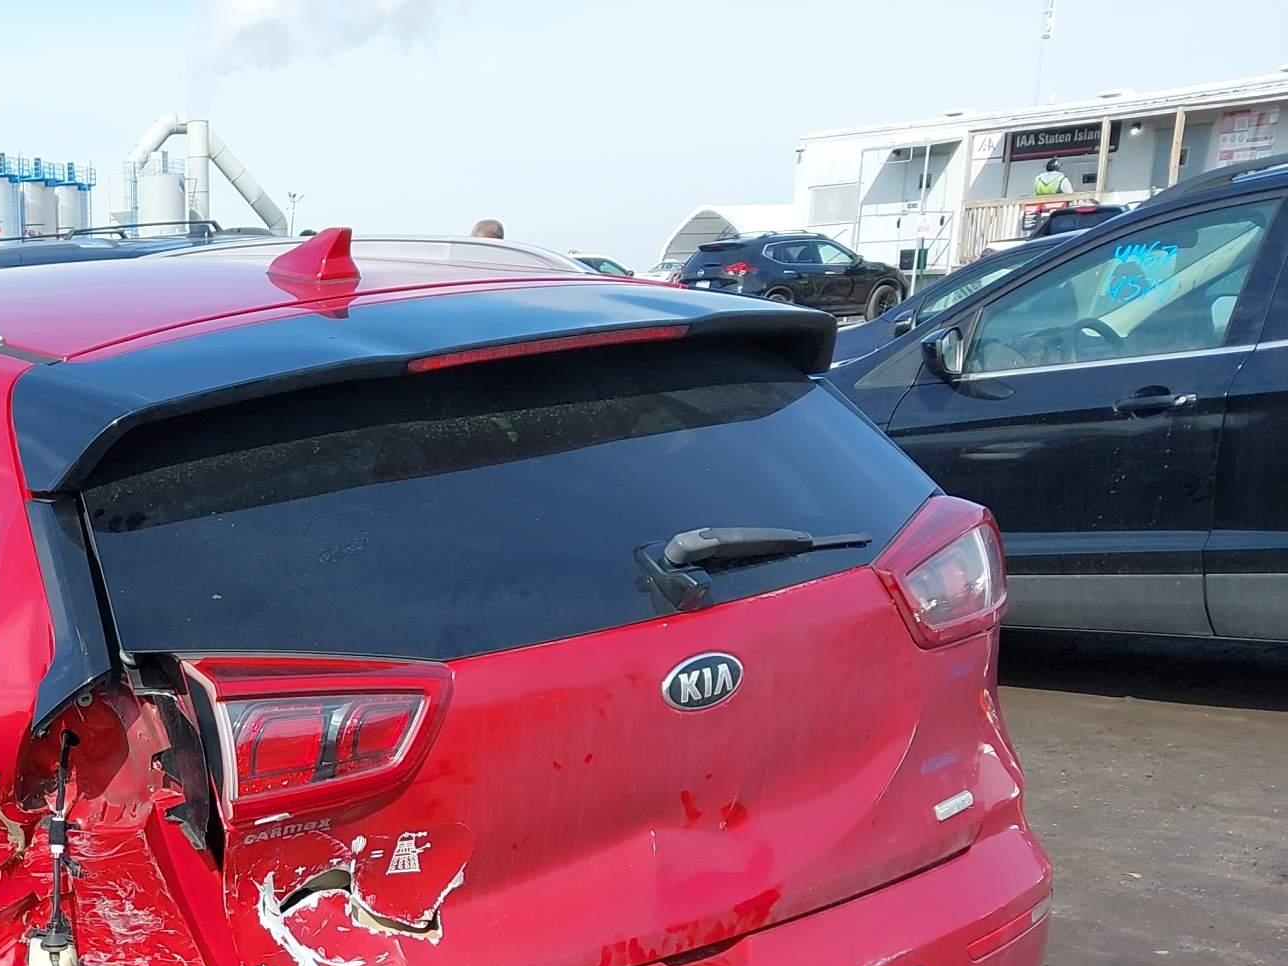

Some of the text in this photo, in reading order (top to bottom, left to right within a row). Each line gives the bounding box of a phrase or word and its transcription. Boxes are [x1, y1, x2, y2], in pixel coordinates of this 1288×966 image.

[1016, 127, 1101, 148] IAA Staten Islan
[678, 663, 733, 703] KIA
